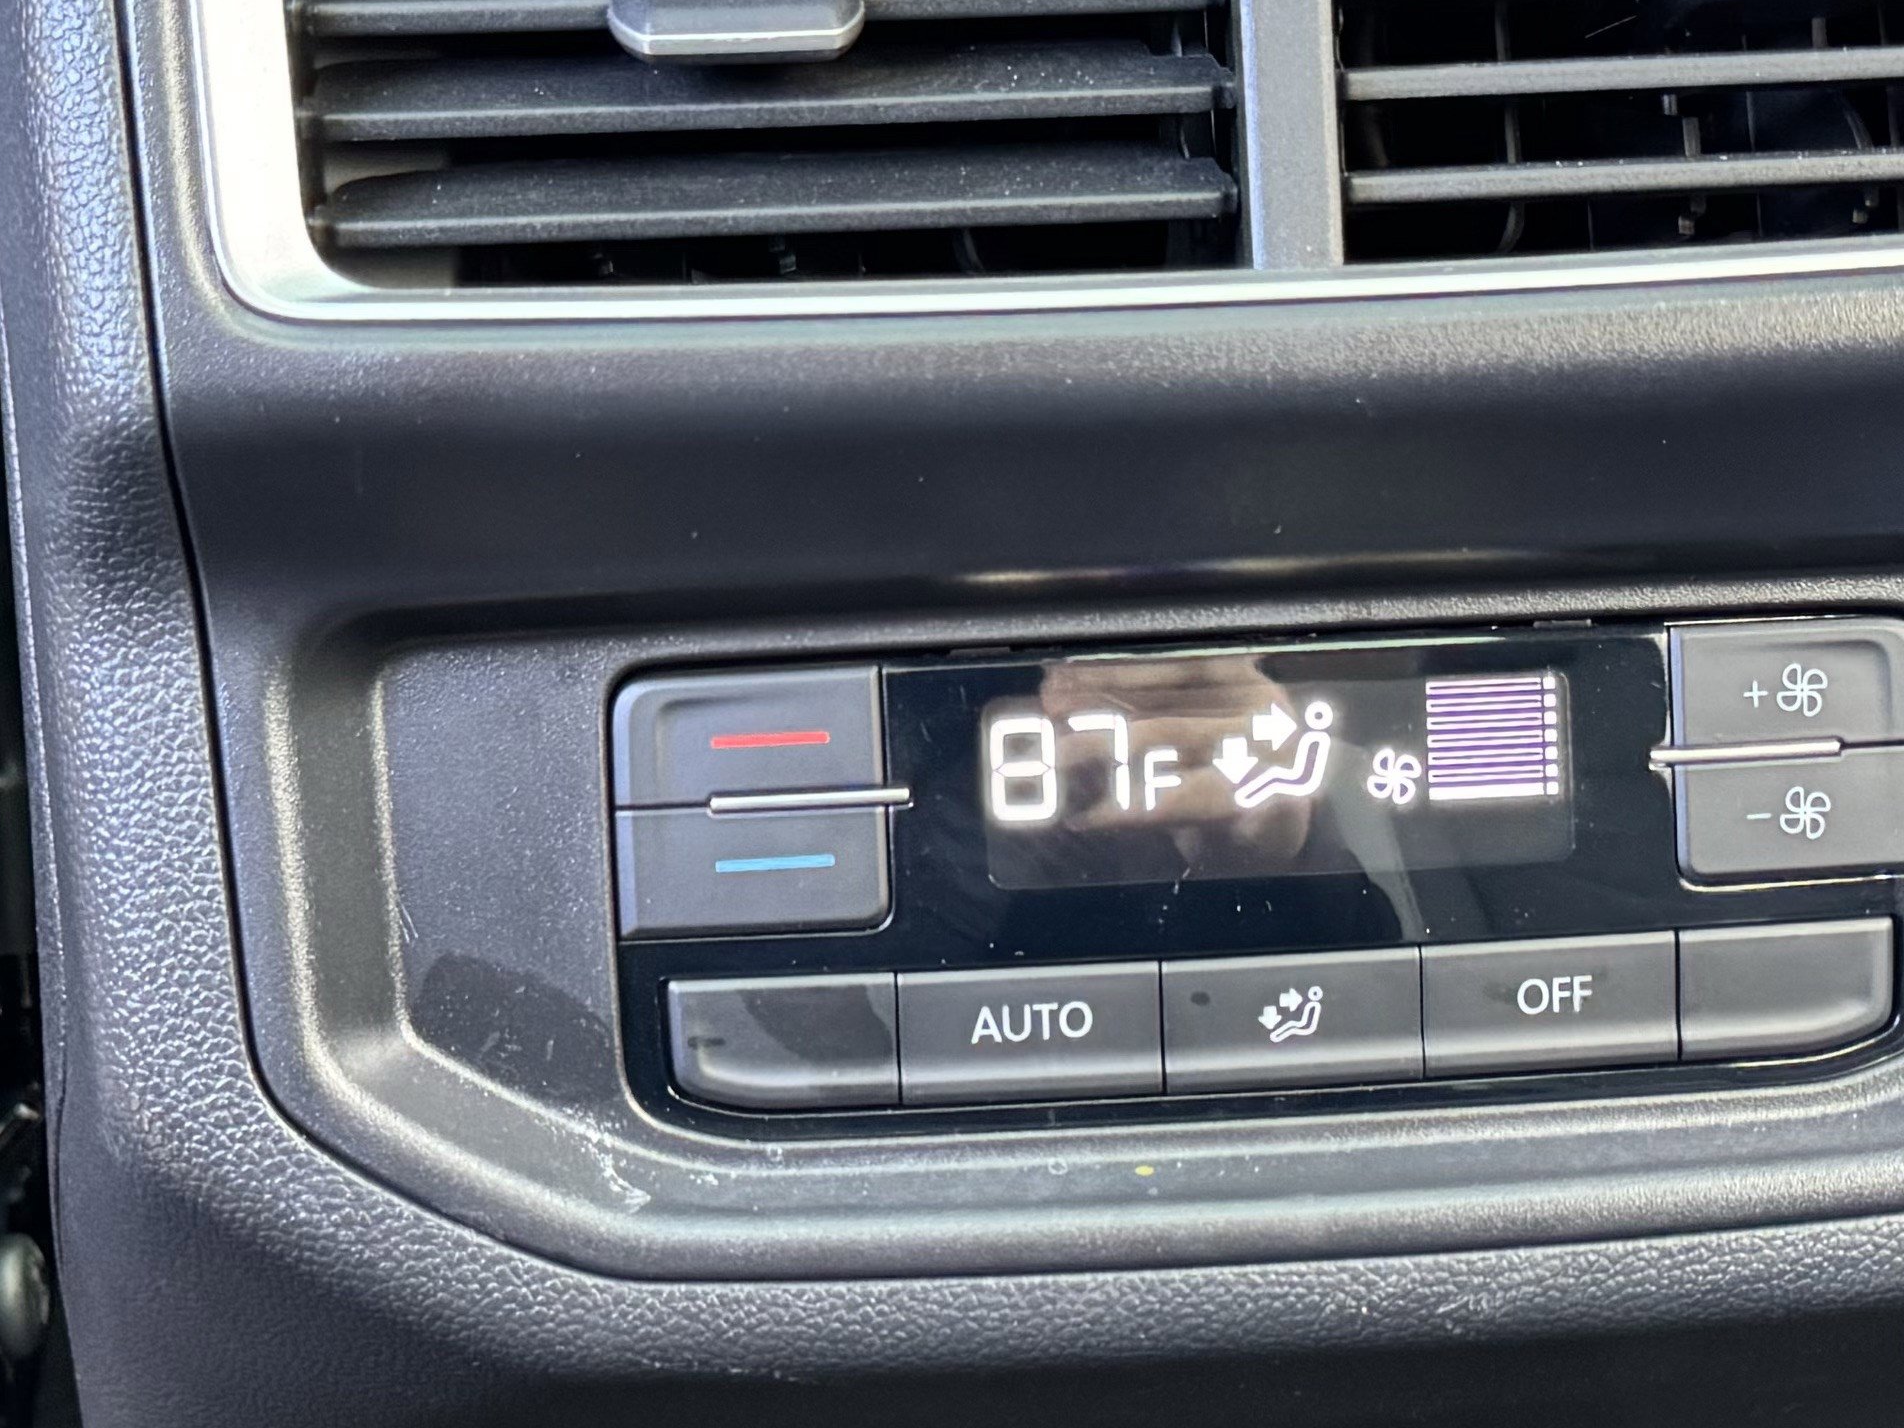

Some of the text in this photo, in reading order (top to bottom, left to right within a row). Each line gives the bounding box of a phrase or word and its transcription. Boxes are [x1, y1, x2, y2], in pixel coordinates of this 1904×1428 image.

[990, 714, 1182, 821] 87F
[1516, 974, 1593, 1015] OFF
[970, 1000, 1094, 1045] AUTO
